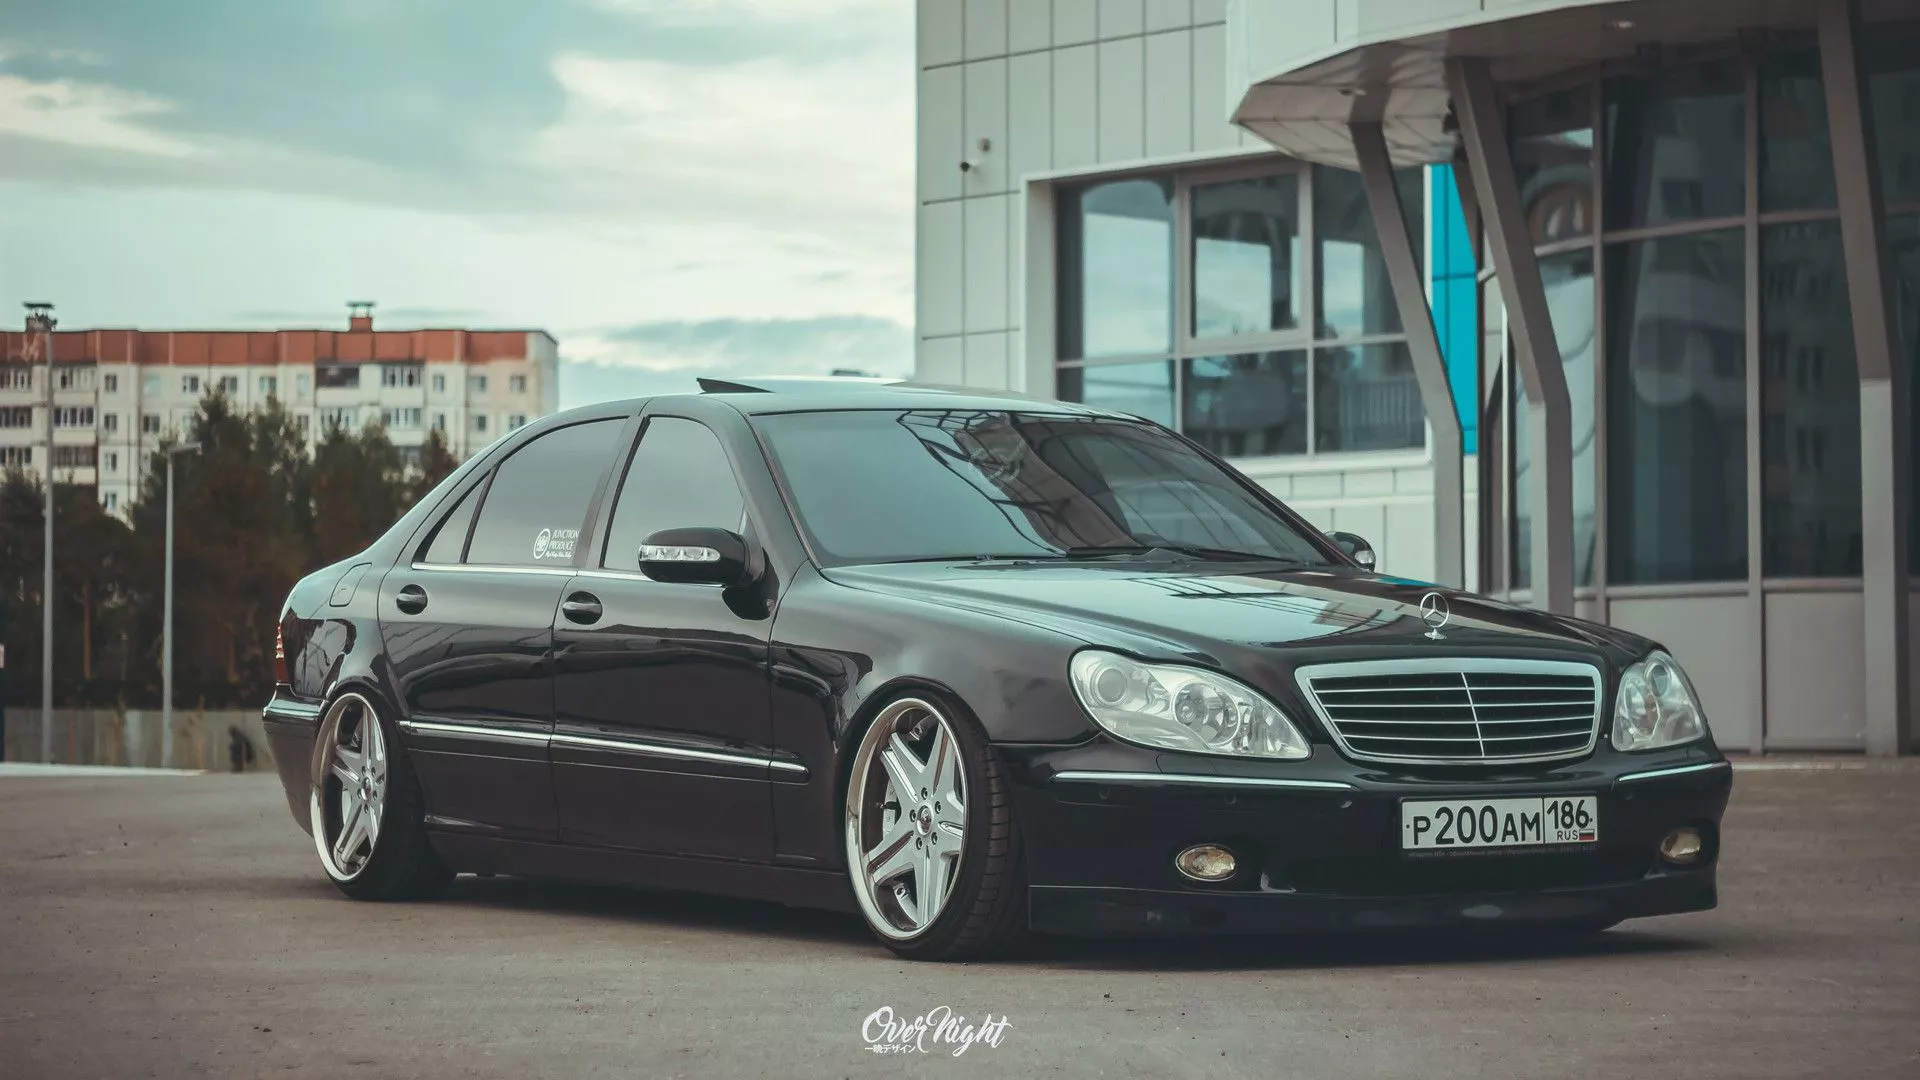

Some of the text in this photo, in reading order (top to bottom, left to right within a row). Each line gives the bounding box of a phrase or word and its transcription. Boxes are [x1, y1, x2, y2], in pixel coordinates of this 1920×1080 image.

[552, 530, 579, 539] JUNCTION
[1547, 800, 1590, 829] 186
[1557, 828, 1579, 841] RUS
